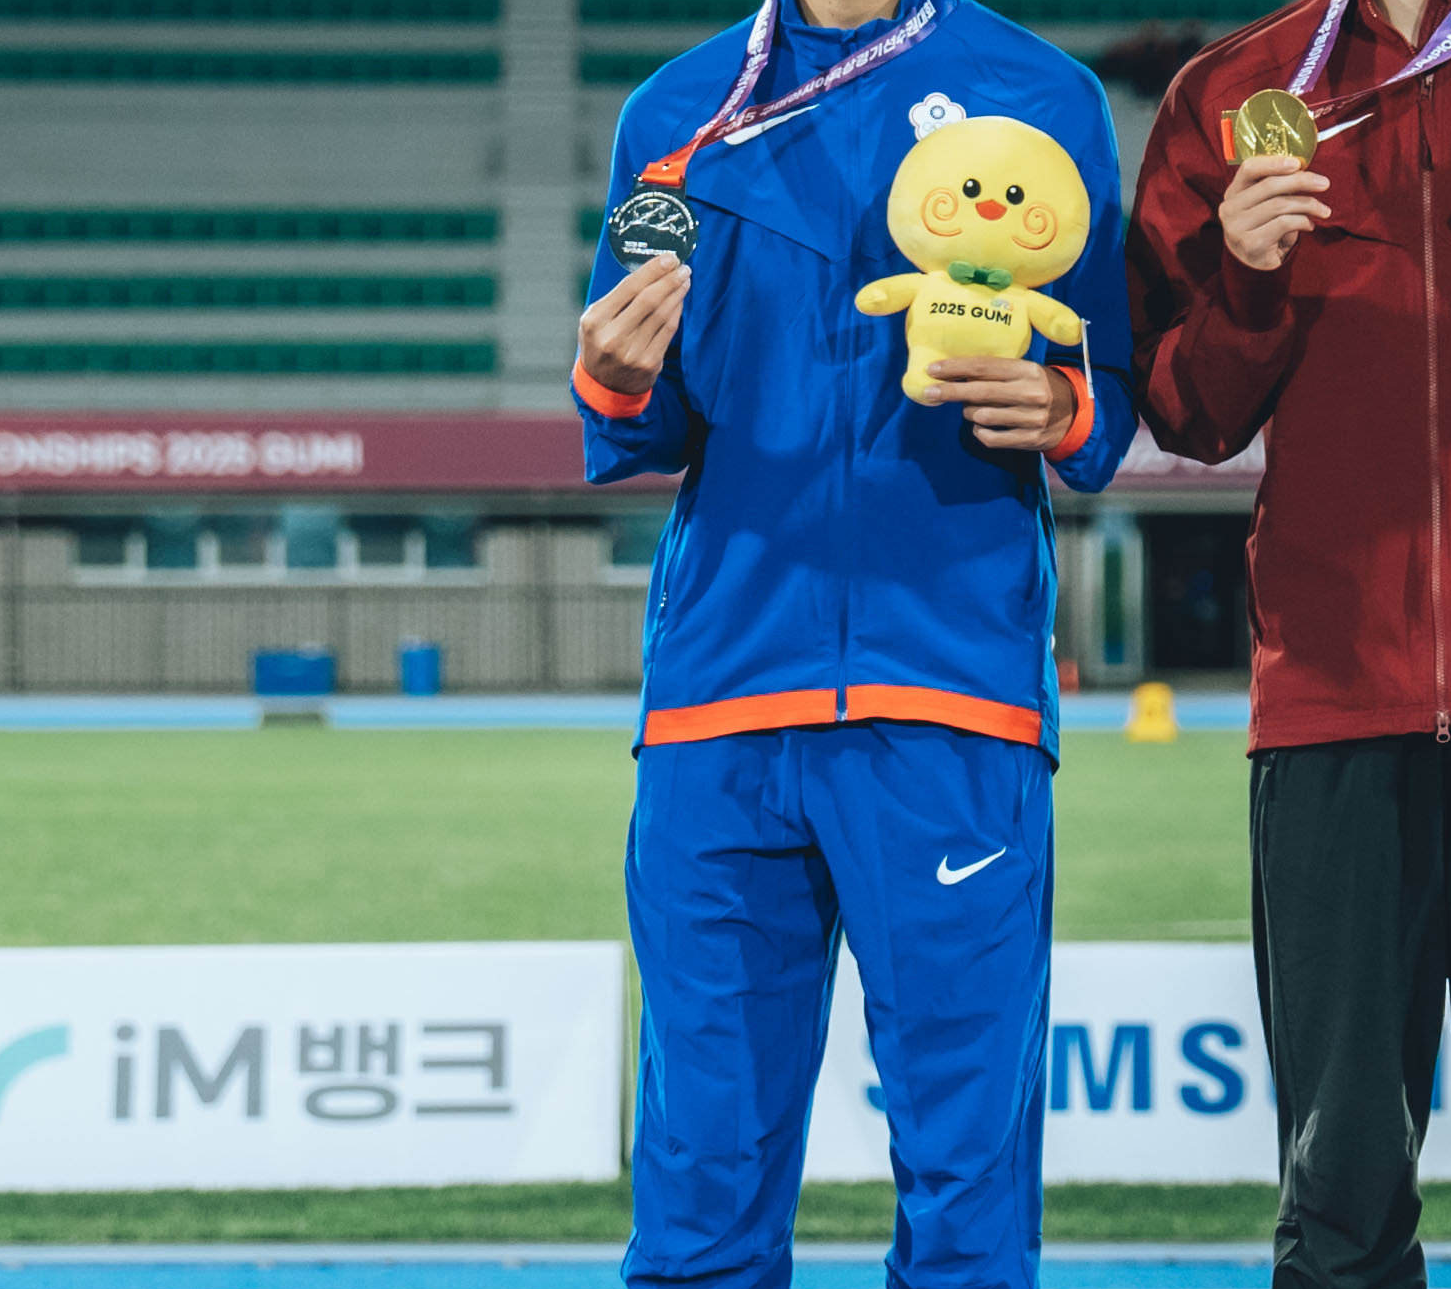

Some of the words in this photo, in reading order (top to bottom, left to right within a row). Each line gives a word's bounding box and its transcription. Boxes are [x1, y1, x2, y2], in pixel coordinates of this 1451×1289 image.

[929, 302, 966, 316] 2025
[970, 306, 1012, 326] GUMI
[164, 430, 255, 476] 2025
[257, 430, 365, 476] GUMI
[112, 1023, 266, 1122] iM
[297, 1022, 515, 1123] 뱅크
